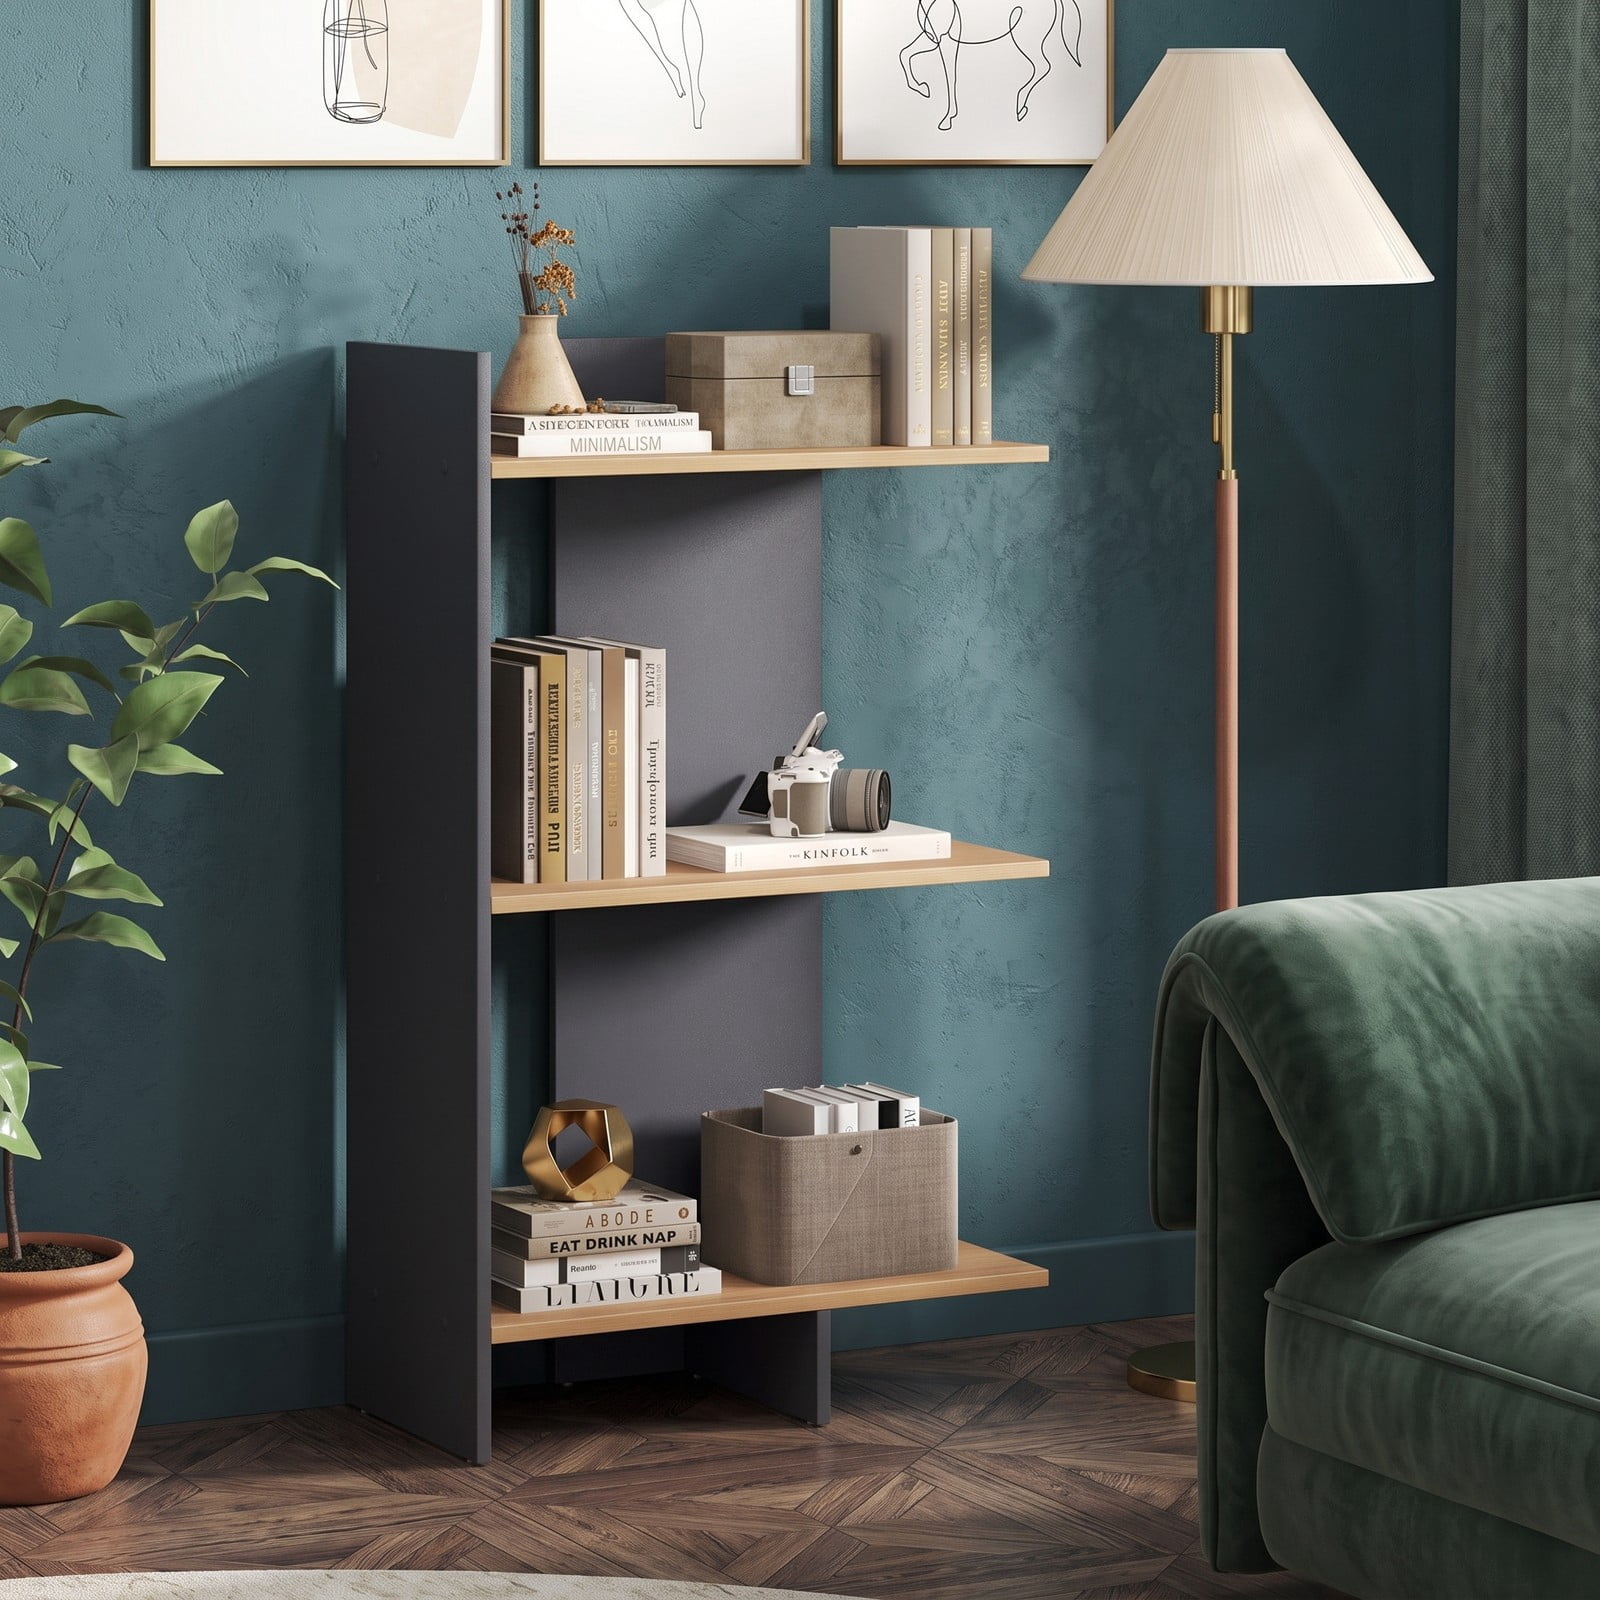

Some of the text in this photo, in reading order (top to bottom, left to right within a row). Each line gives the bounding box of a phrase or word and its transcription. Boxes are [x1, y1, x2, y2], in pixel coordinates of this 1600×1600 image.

[570, 435, 662, 453] MINIMALISM
[803, 846, 869, 860] KINFOLK
[585, 1208, 654, 1229] ABODE
[550, 1238, 581, 1255] EAT
[586, 1233, 638, 1251] DRINK
[642, 1230, 677, 1246] NAP
